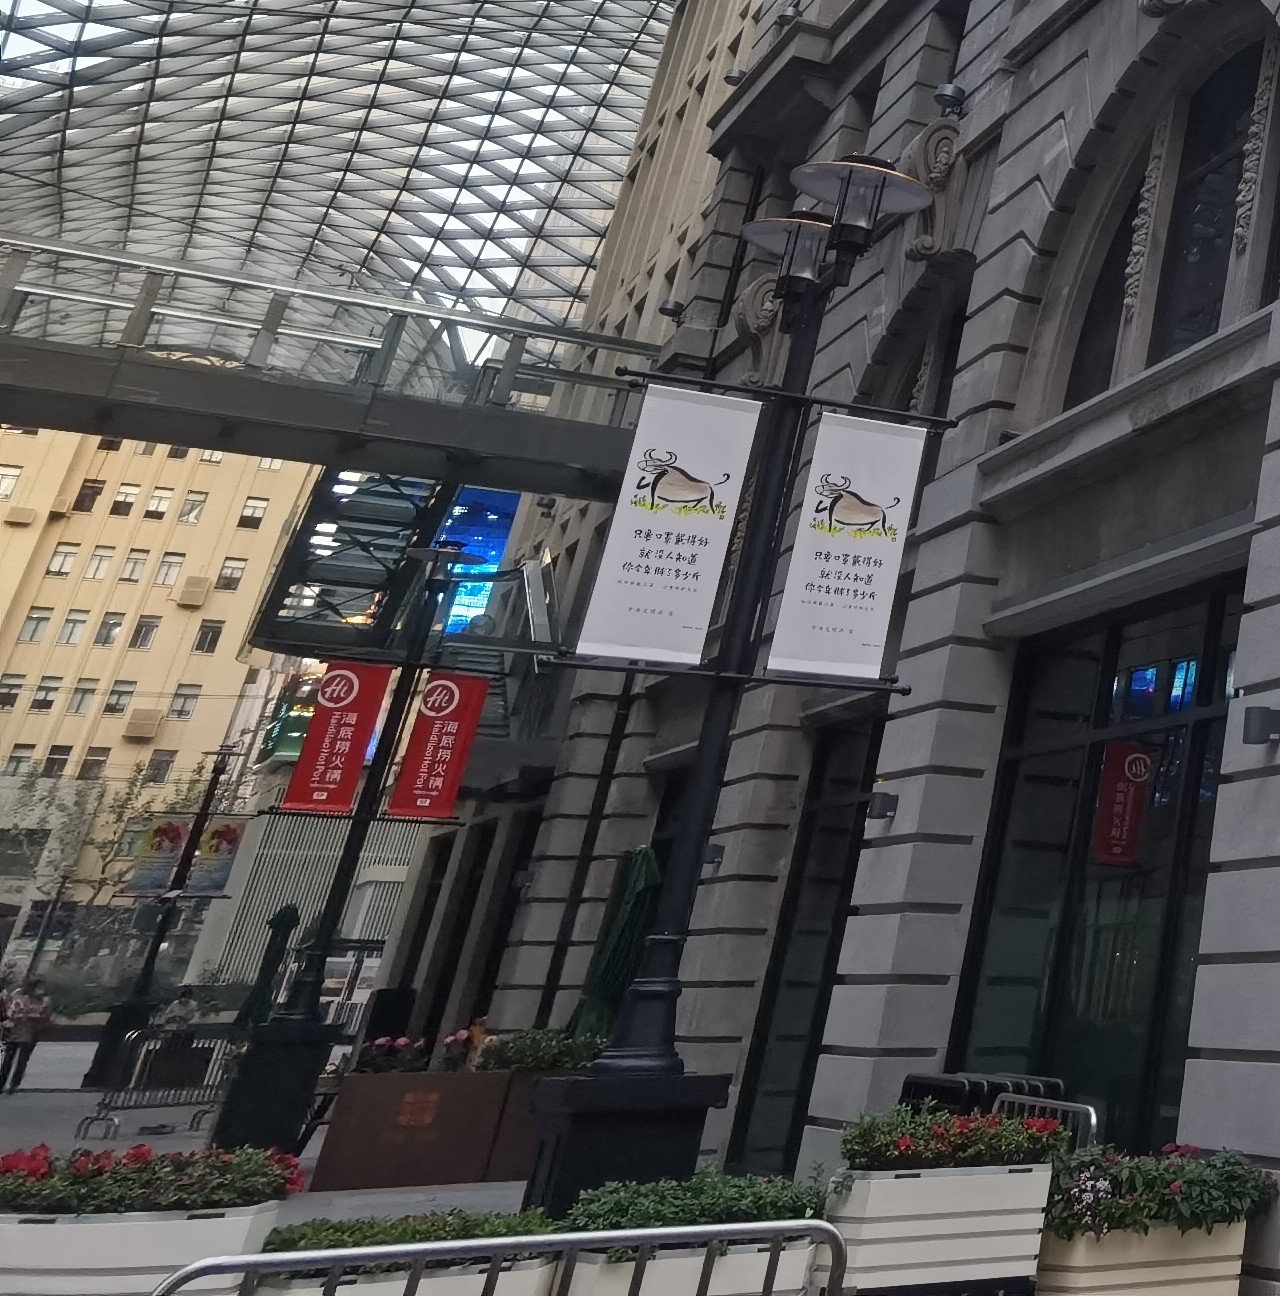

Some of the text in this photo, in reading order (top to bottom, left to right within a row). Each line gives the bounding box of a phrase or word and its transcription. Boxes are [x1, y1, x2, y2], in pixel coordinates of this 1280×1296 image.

[639, 547, 698, 565] 就没人知道
[819, 568, 874, 586] 就没人知道
[325, 712, 359, 783] 海底捞火锅
[428, 721, 459, 789] 海底捞火锅
